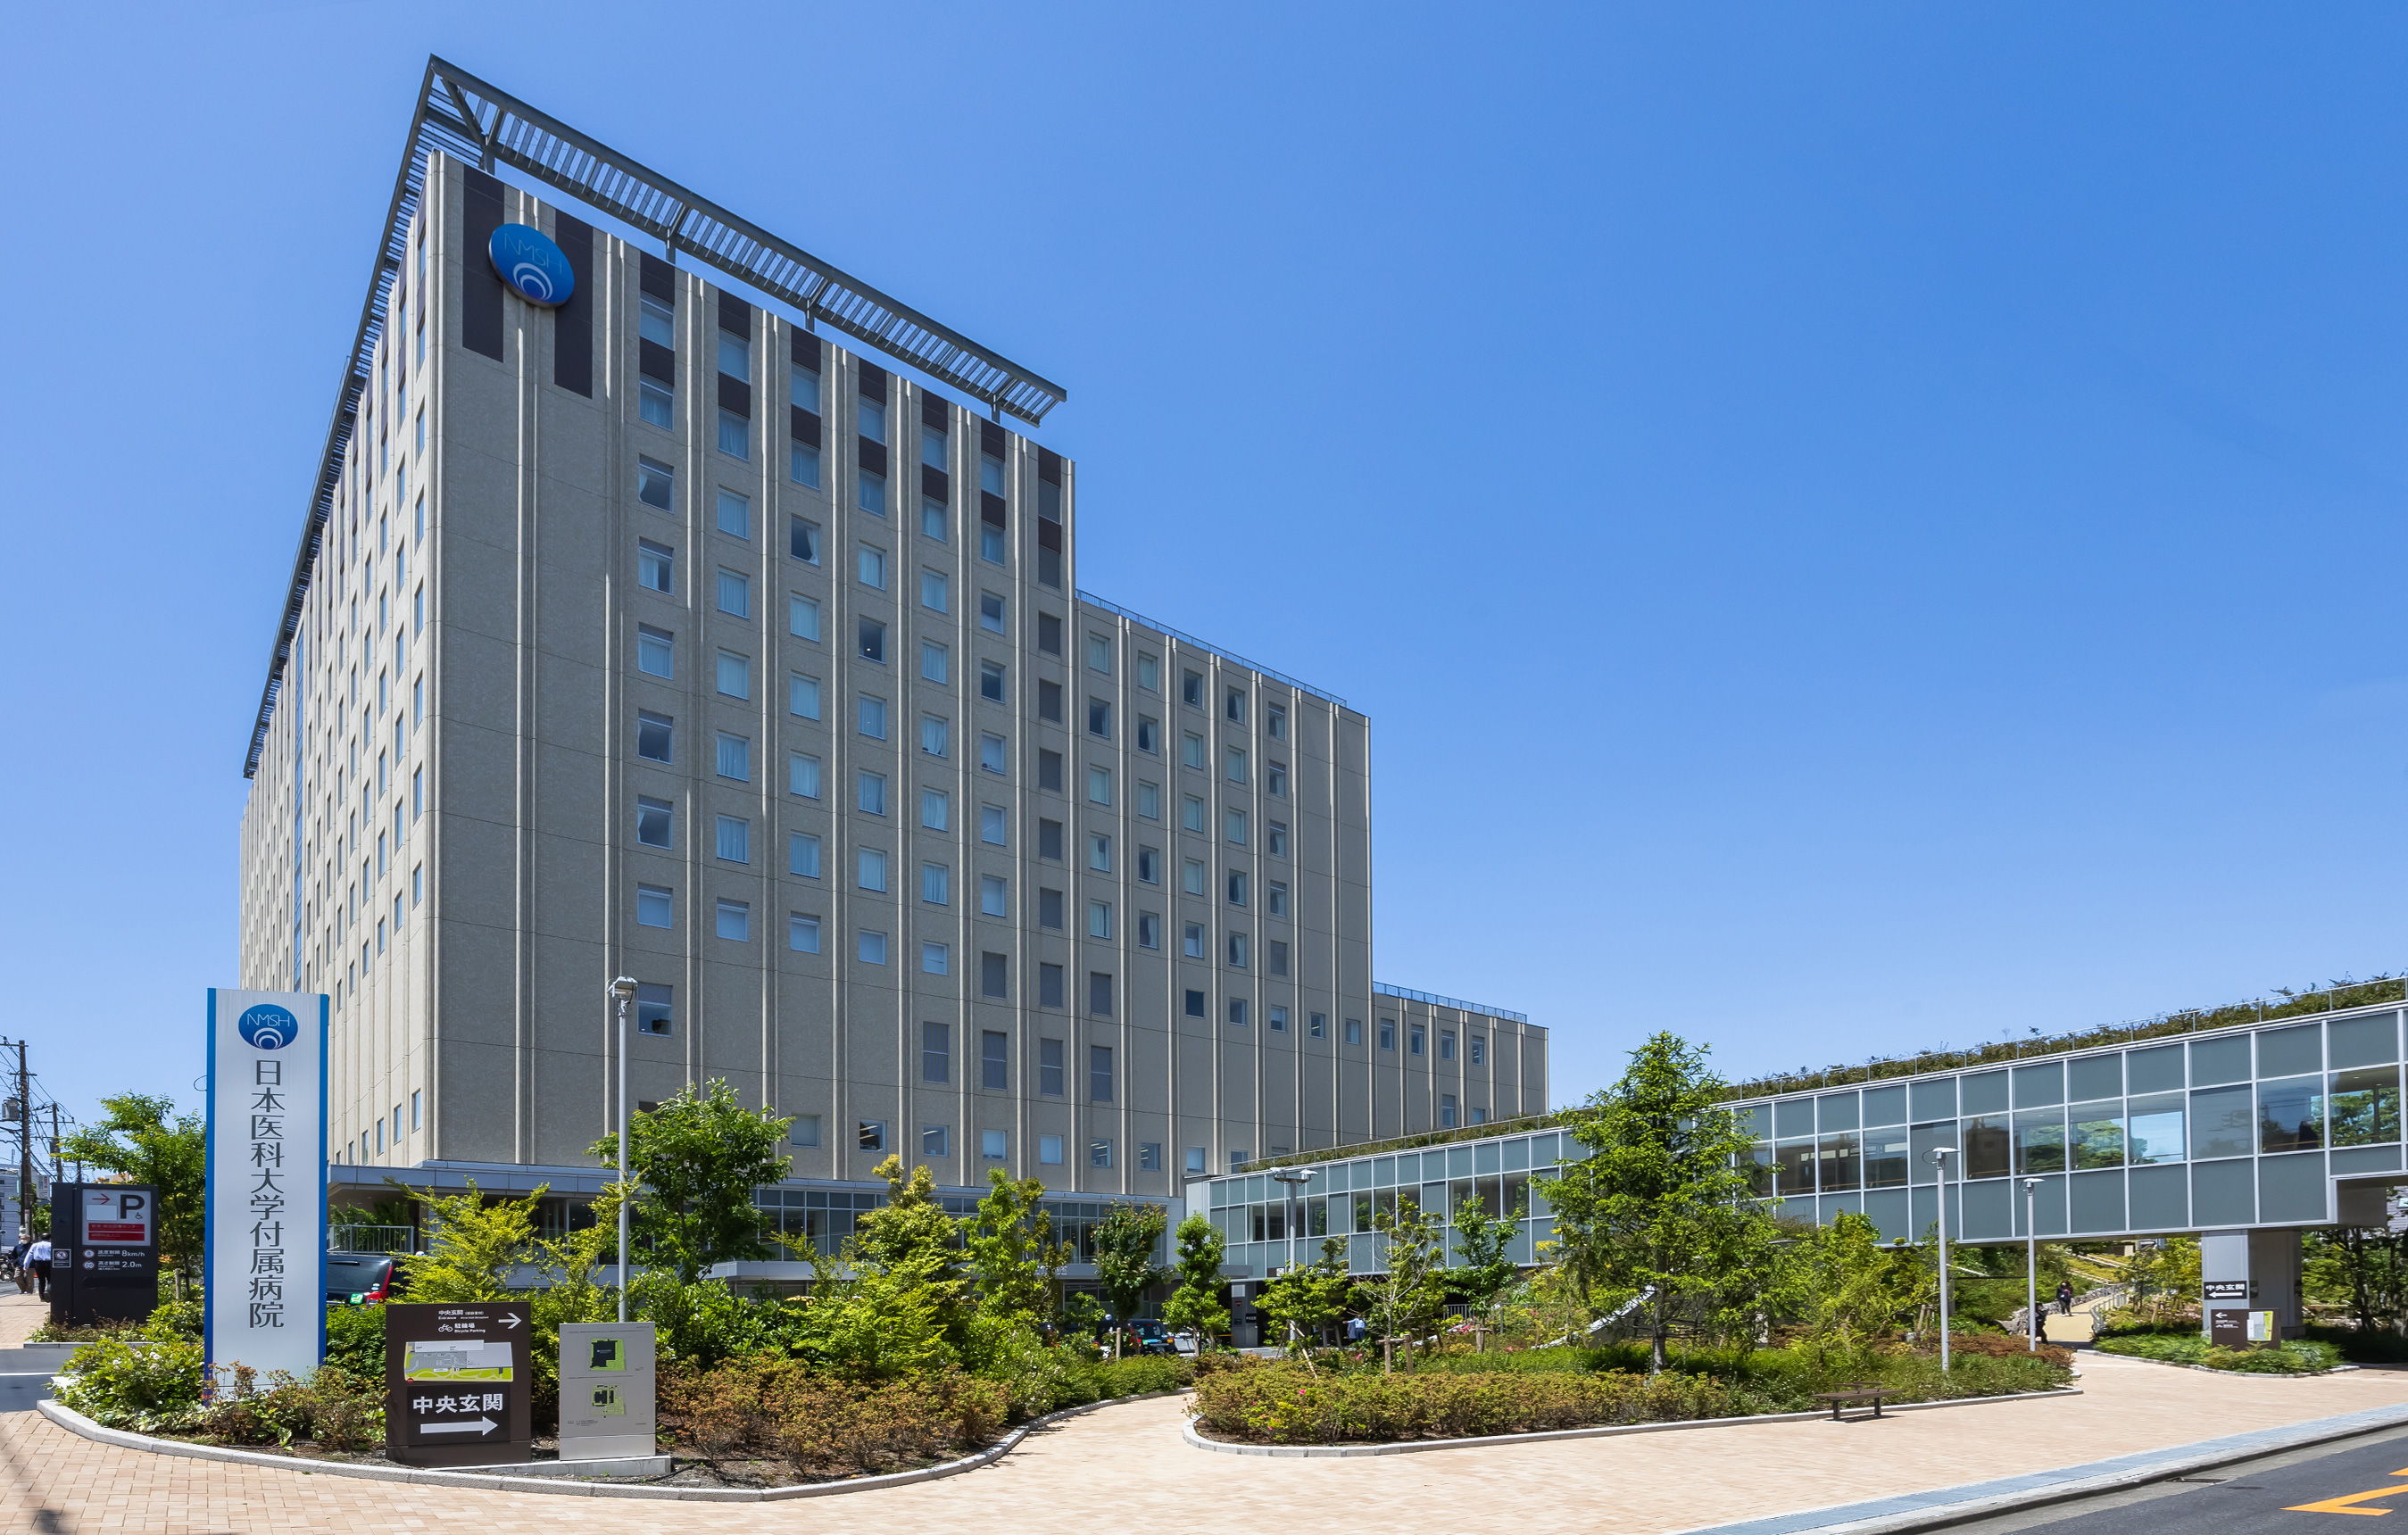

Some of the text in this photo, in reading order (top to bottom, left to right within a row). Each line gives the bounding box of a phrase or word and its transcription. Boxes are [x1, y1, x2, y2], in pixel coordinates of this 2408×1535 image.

[504, 232, 562, 275] NMSH
[246, 1013, 290, 1027] NMSH
[249, 1059, 286, 1329] 日本医科大学付属病院
[120, 1194, 145, 1219] P
[2205, 1283, 2246, 1291] 中央玄関
[412, 1393, 503, 1415] 中央玄関
